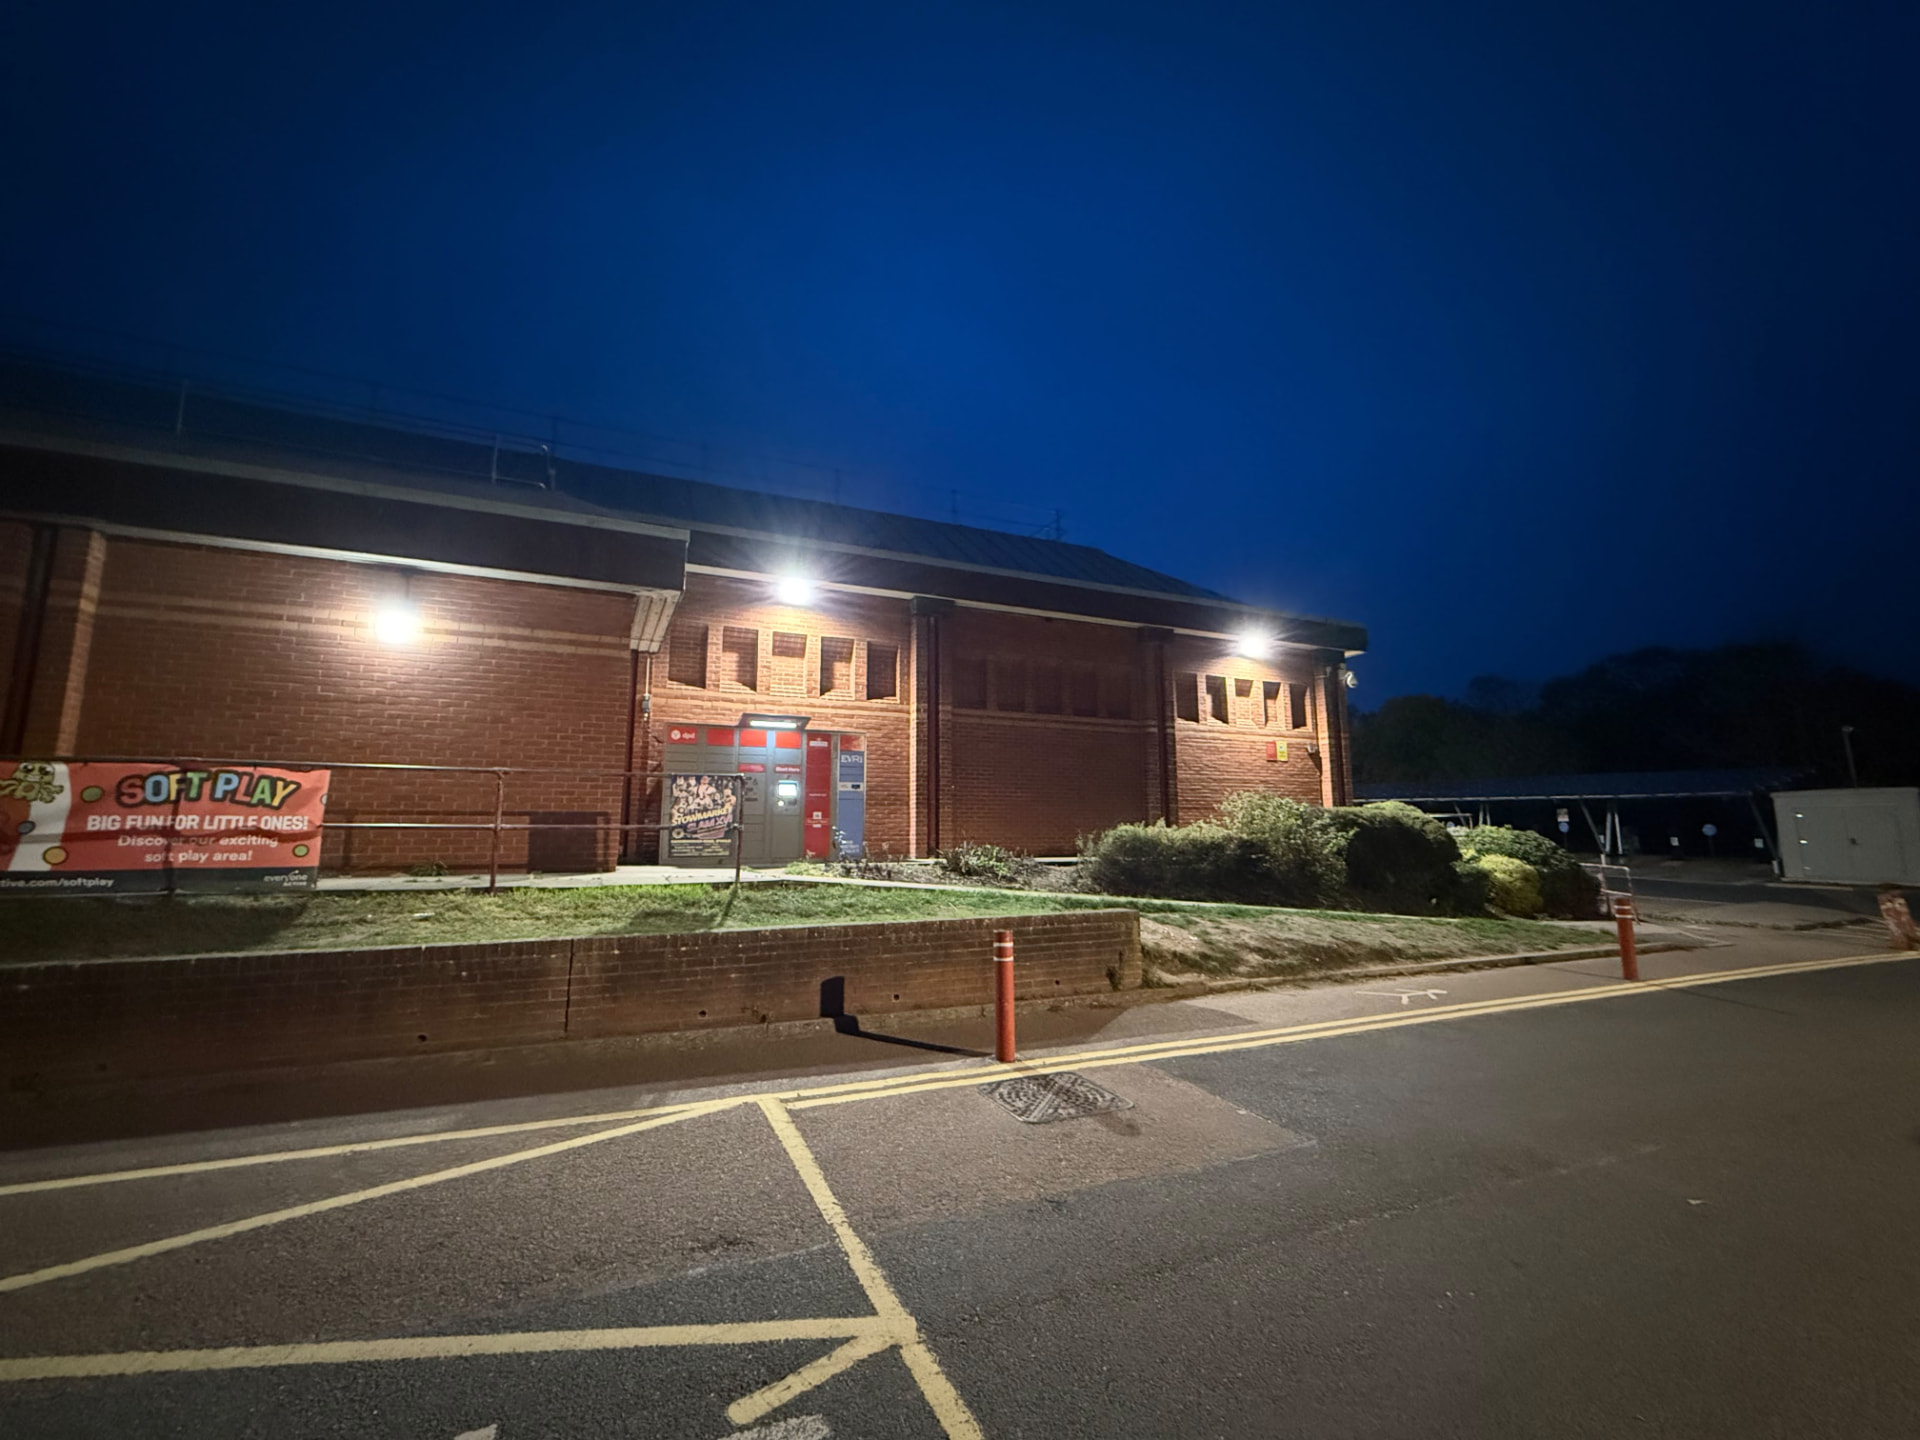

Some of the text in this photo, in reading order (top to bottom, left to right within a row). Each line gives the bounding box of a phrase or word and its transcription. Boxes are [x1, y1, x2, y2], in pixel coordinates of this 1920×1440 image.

[118, 771, 298, 807] SOFT PLAY
[87, 814, 309, 830] BIG FUN FOR LITTLE ONES!
[117, 834, 278, 847] Discover our exciting
[178, 850, 209, 863] play
[212, 850, 253, 862] area!
